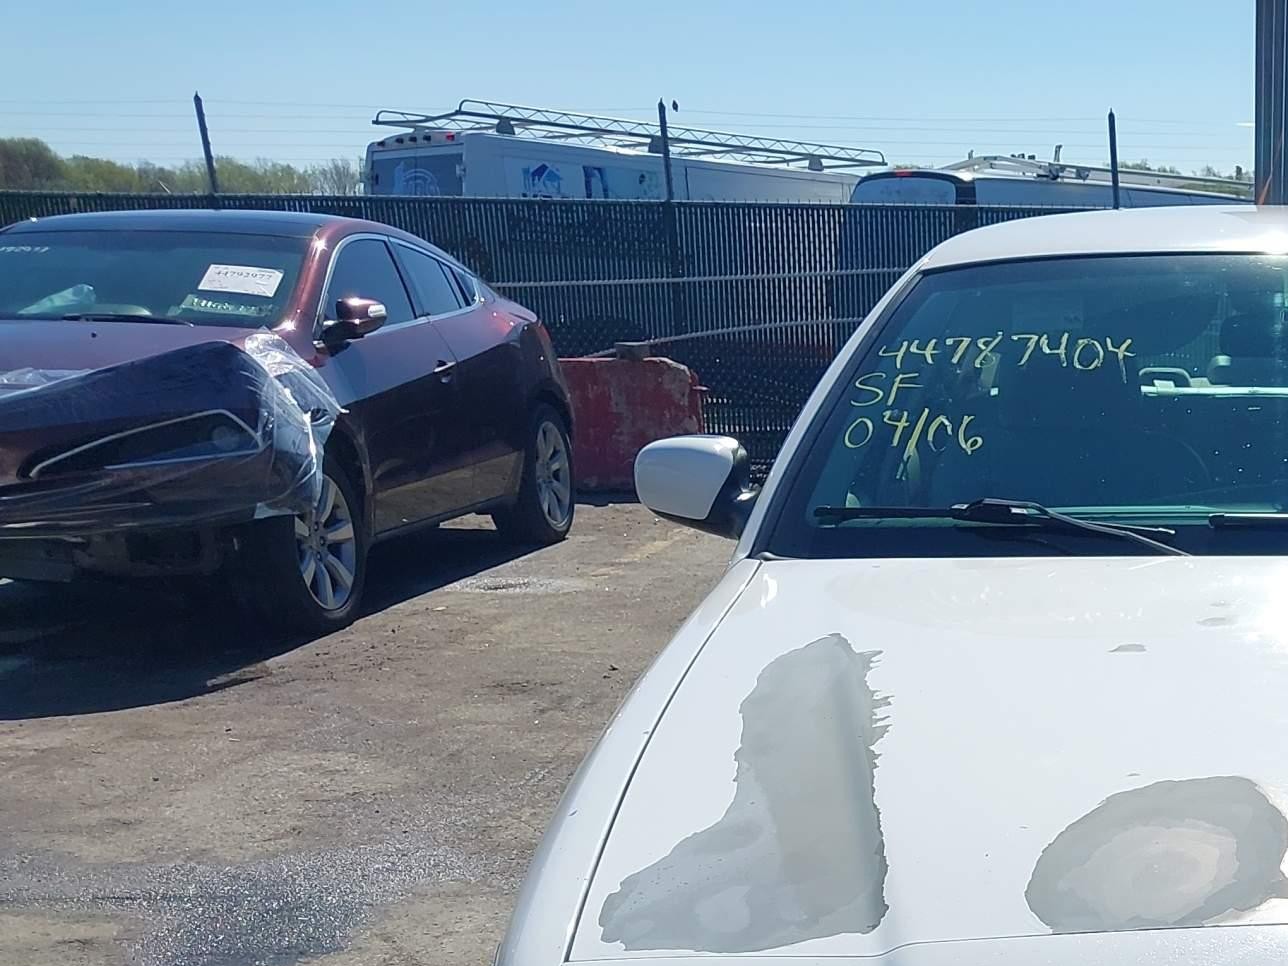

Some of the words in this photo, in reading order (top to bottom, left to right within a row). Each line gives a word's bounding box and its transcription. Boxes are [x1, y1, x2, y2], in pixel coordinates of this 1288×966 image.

[878, 331, 1137, 384] 44787404
[850, 372, 924, 406] SF
[844, 407, 983, 480] 04/06
